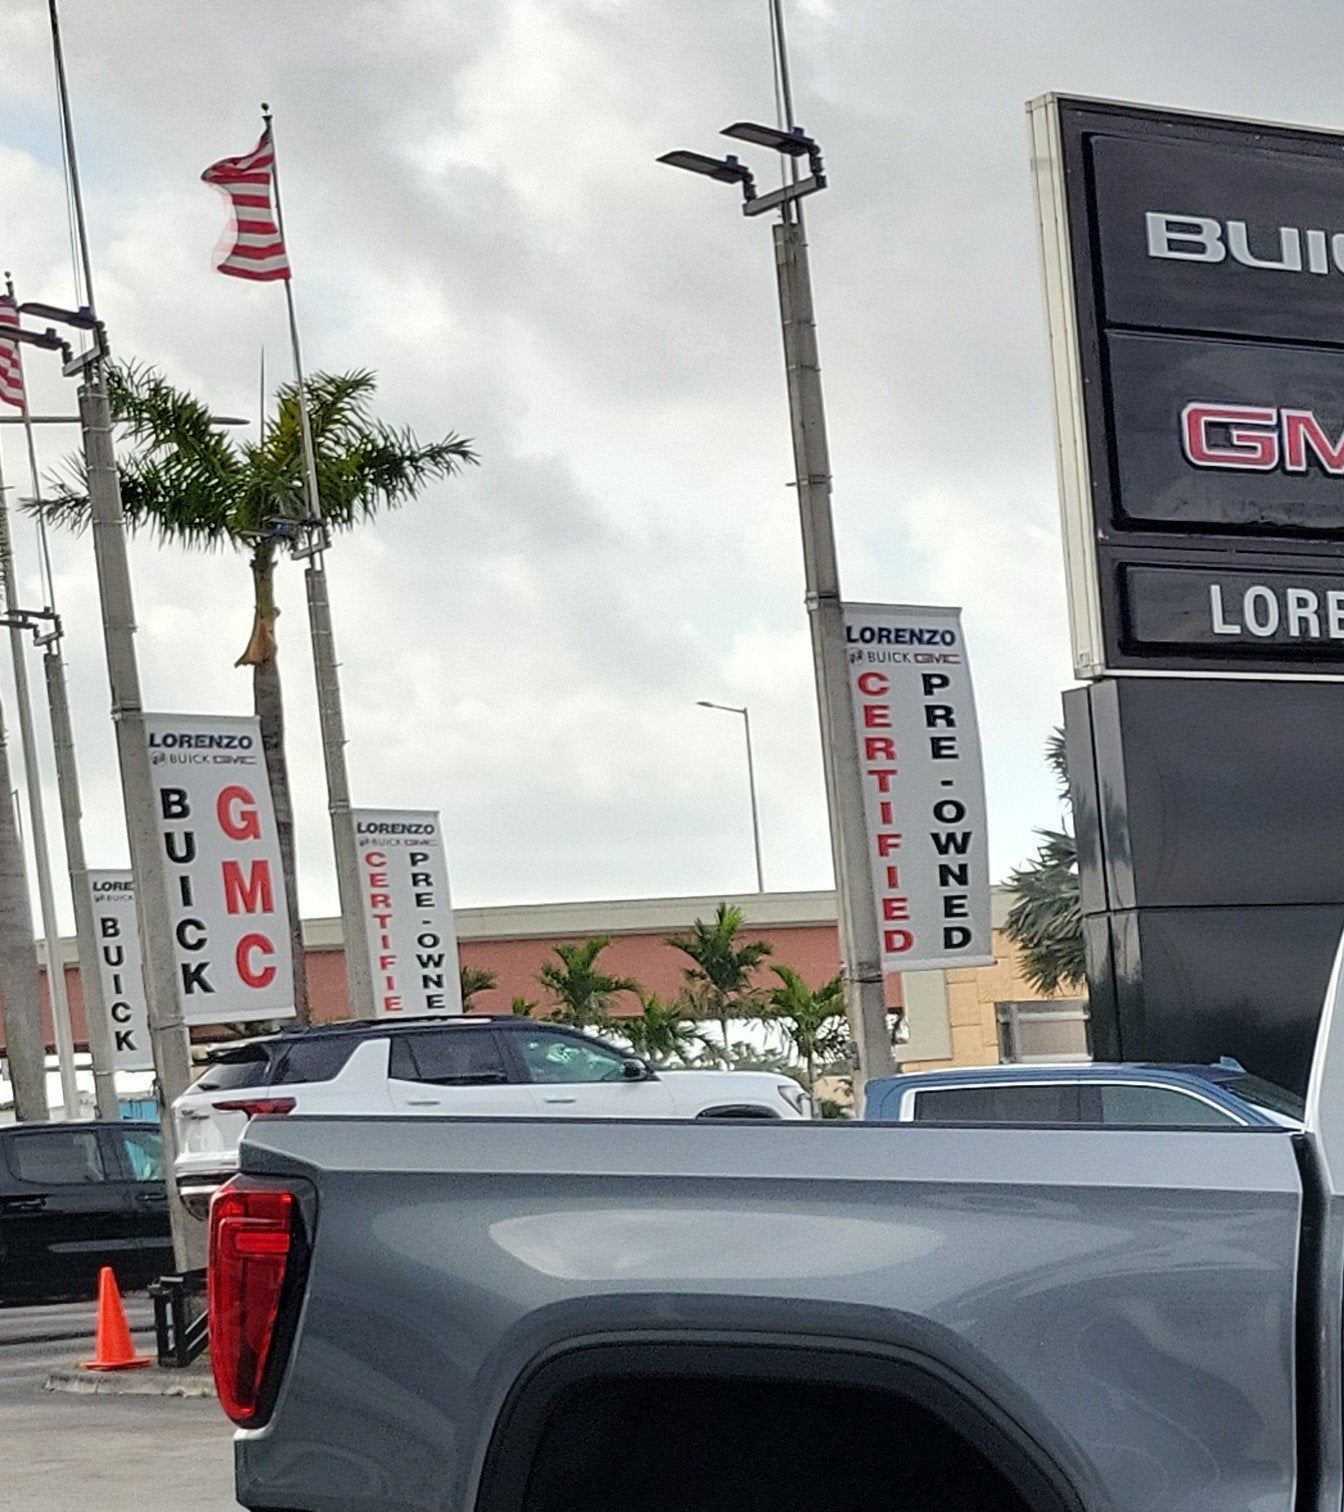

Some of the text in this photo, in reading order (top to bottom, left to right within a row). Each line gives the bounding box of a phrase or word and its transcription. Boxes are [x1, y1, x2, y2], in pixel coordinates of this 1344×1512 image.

[846, 626, 956, 646] LORENZO
[868, 652, 961, 665] BUICK GMC
[149, 733, 253, 749] LORENZO
[169, 754, 210, 764] BUICK
[357, 822, 435, 835] LORENZO
[857, 671, 914, 953] CERTIFIED
[921, 673, 972, 950] PRE-OWNED
[93, 882, 134, 892] LORE
[160, 788, 215, 995] BUICK
[216, 785, 277, 988] GMC
[365, 852, 403, 1011] CERTIFIE
[410, 852, 445, 1009] PRE-OWNE
[101, 917, 137, 1051] BUICK
